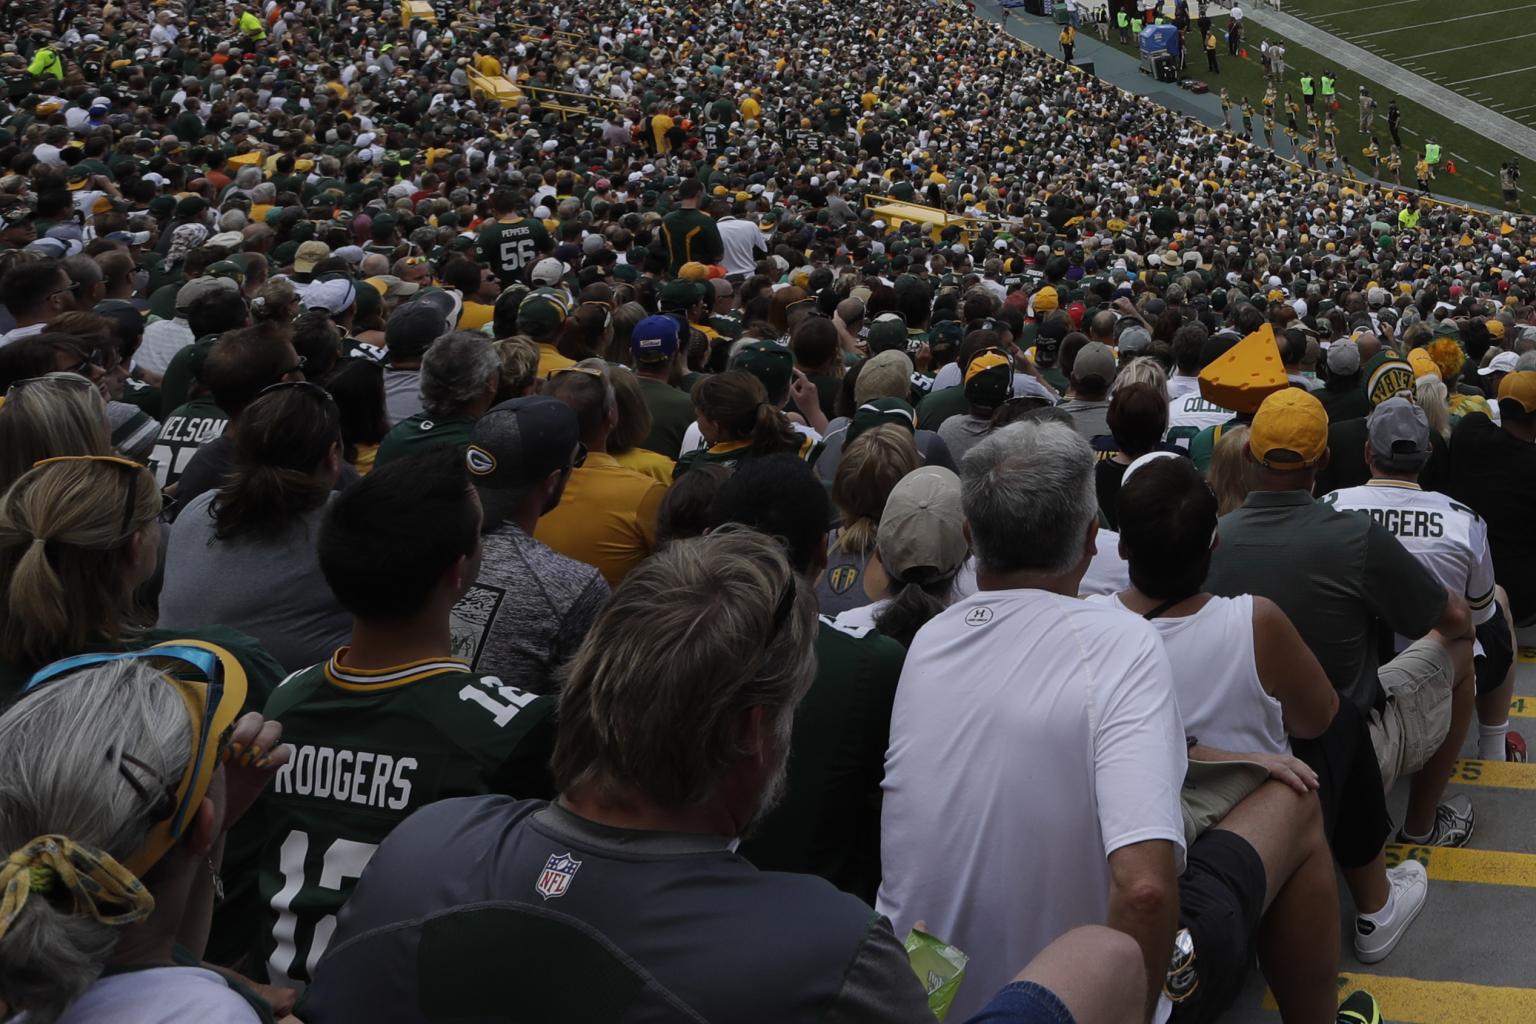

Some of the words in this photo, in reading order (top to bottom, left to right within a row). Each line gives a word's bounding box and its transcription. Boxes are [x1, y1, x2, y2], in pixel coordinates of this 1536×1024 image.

[501, 226, 530, 238] PEPPERS
[499, 240, 536, 271] 56
[1351, 508, 1444, 538] DGERS
[458, 674, 540, 728] 12
[275, 742, 419, 811] RODGERS
[539, 869, 566, 894] NFL
